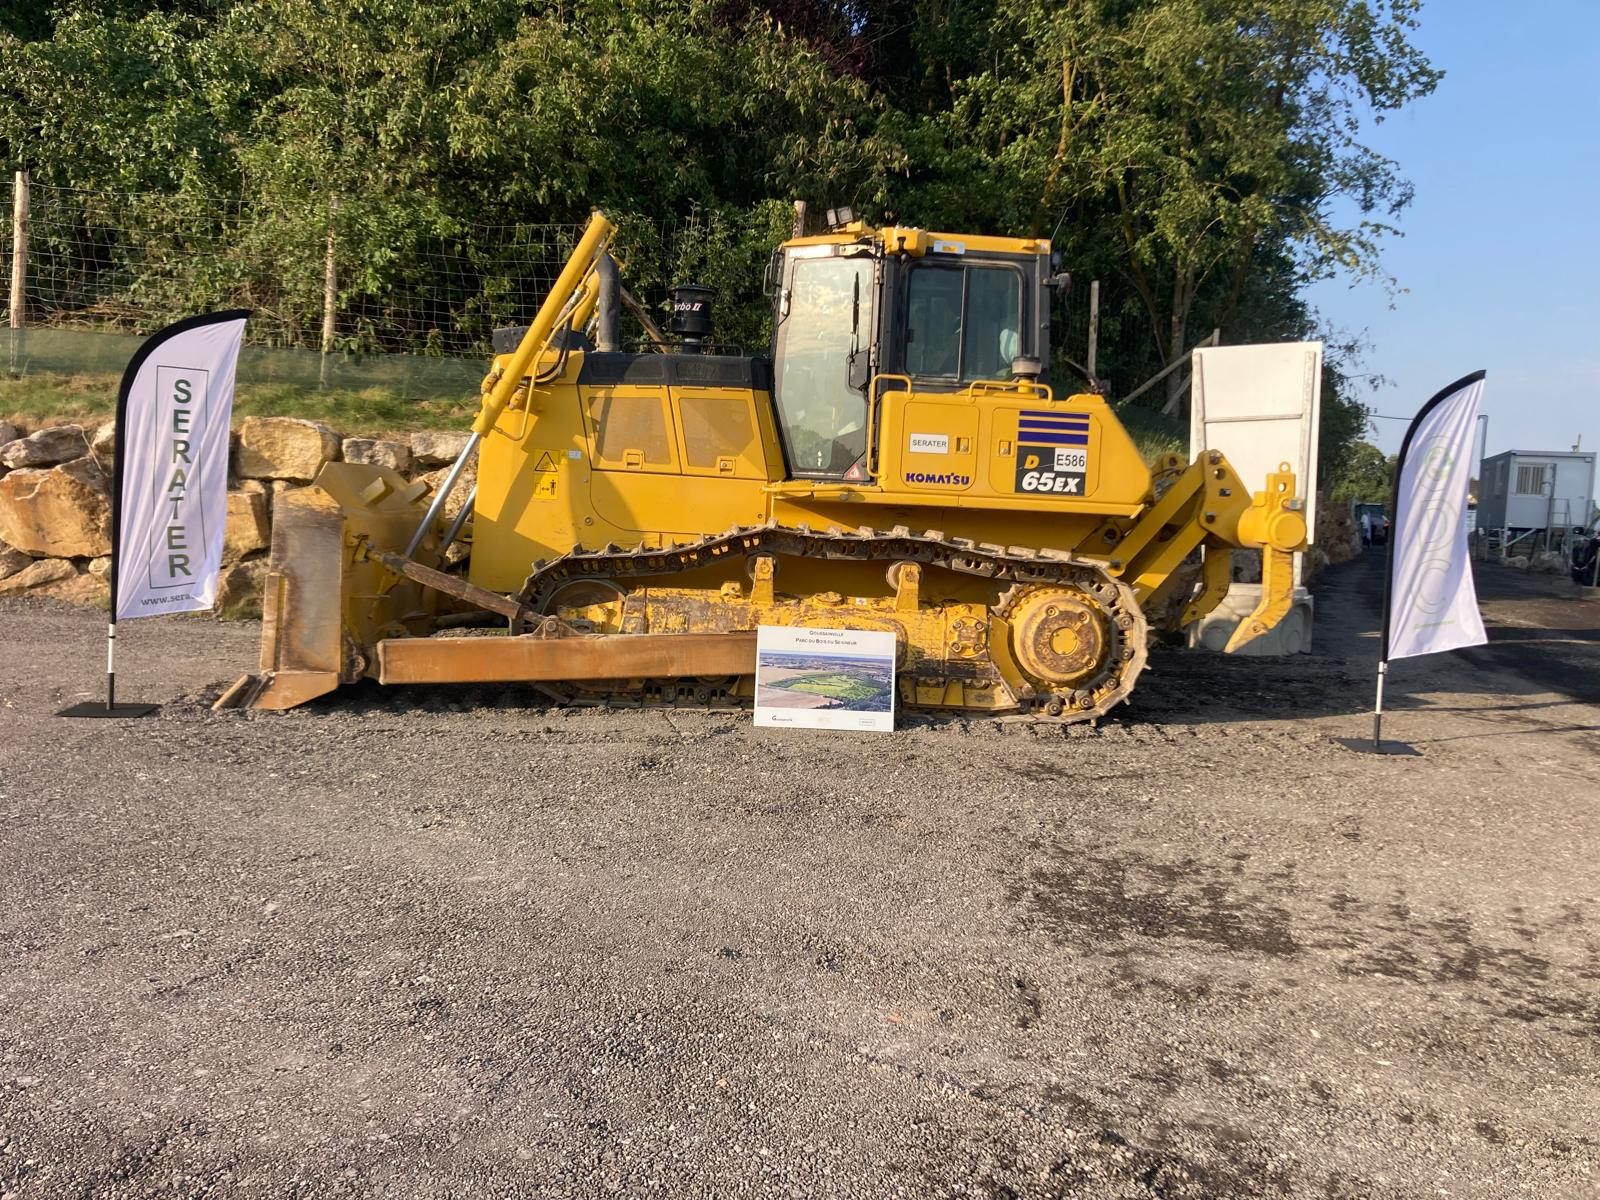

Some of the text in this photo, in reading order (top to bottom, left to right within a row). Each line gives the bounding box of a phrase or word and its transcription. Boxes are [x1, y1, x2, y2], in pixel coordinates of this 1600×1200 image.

[912, 439, 947, 448] SERATER
[1023, 454, 1040, 470] D
[1056, 453, 1085, 468] E586
[167, 379, 192, 579] SERATER
[905, 472, 970, 486] KOMATSU
[1021, 471, 1081, 493] 65EX
[140, 593, 196, 606] www.sera
